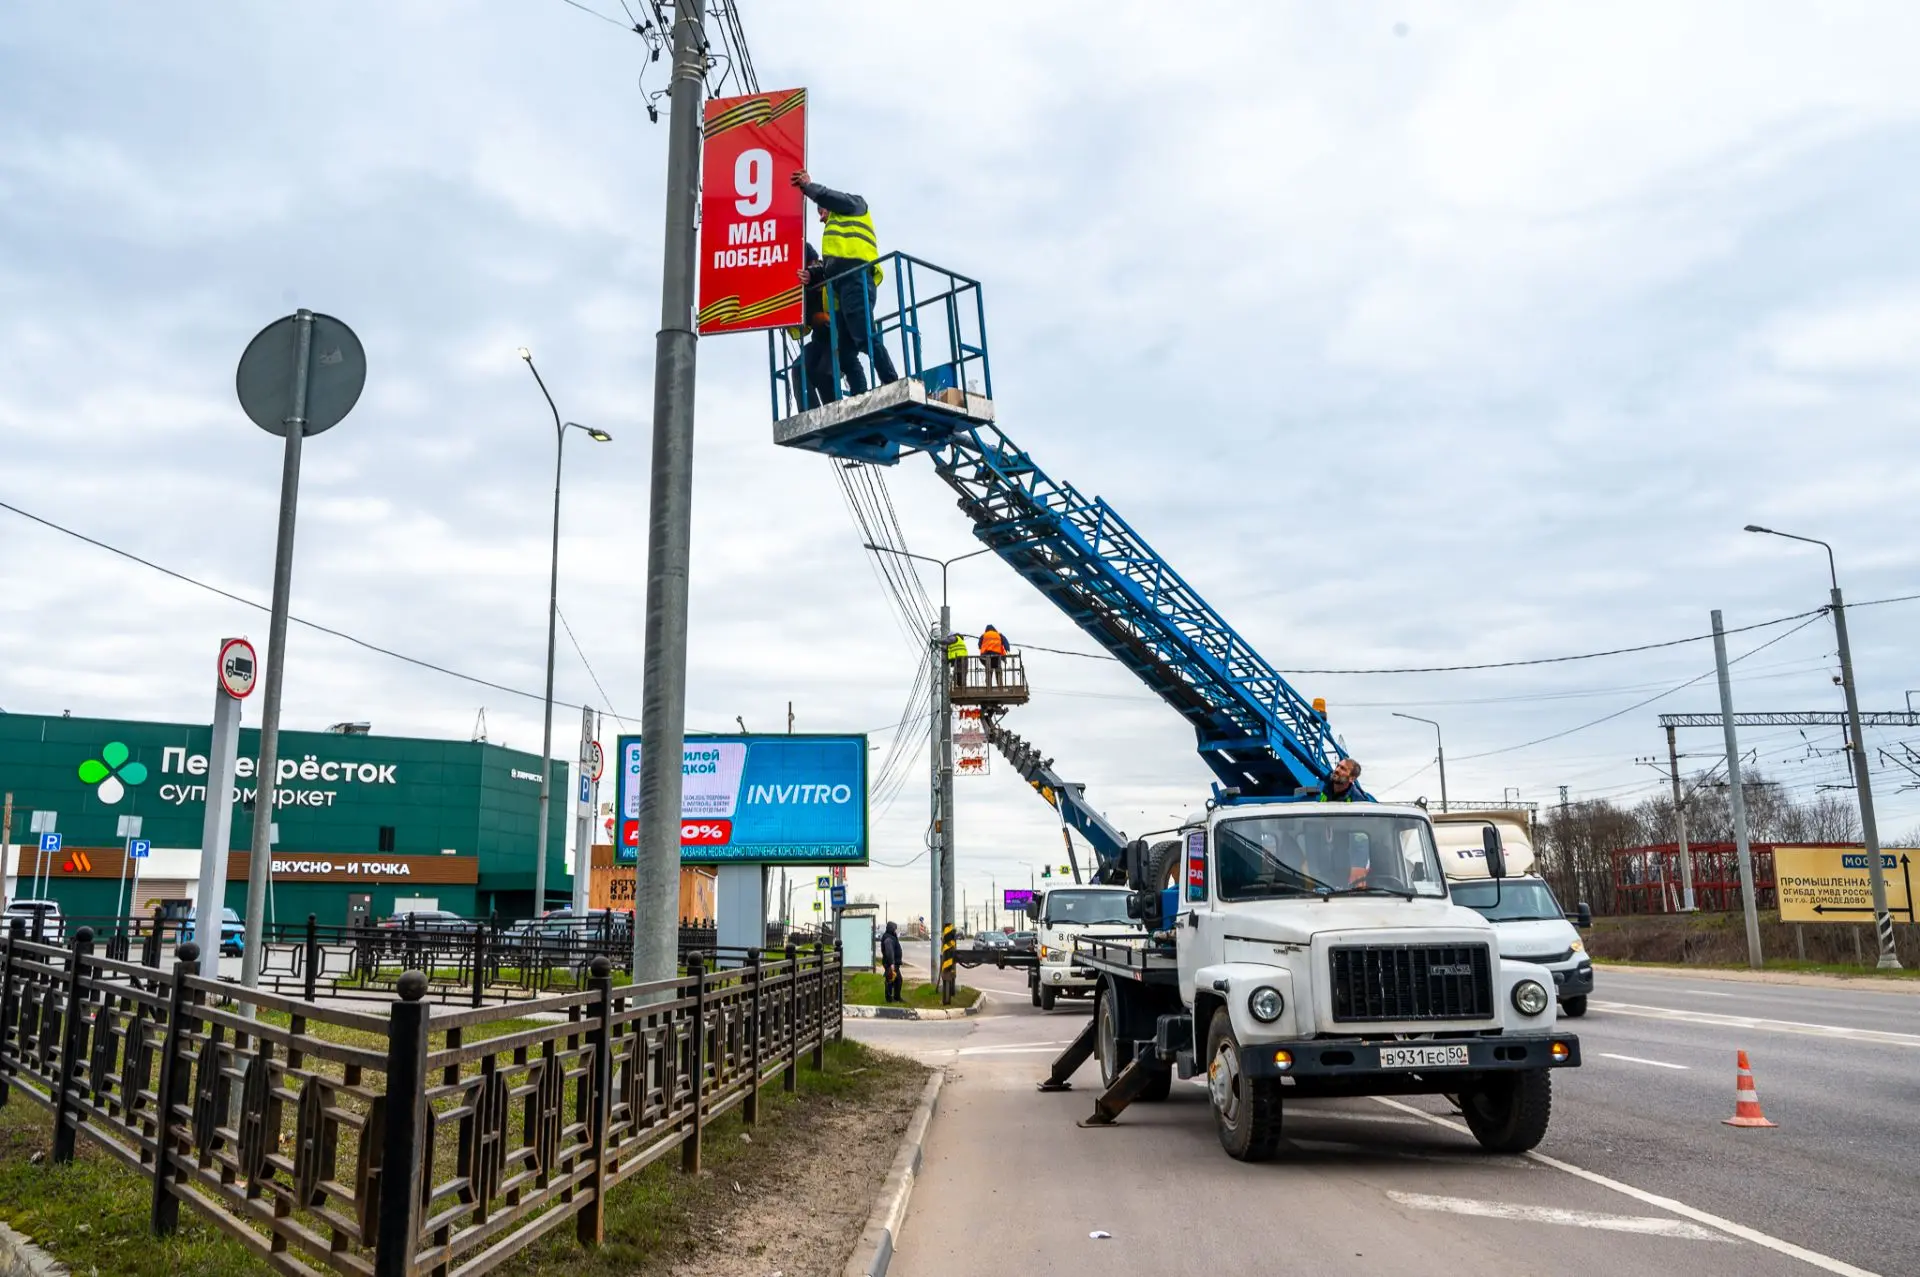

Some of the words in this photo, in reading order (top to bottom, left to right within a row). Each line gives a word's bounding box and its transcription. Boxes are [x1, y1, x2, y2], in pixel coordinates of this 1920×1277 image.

[735, 148, 773, 217] 9
[728, 219, 777, 246] МАЯ
[714, 243, 789, 269] ПОБЕДА!
[683, 749, 720, 761] илей
[161, 747, 397, 785] Пеерёсток
[682, 762, 717, 775] дкой
[746, 784, 852, 804] INVITRO
[681, 825, 723, 839] 0%
[271, 860, 332, 873] ВКУСНО
[347, 862, 359, 874] И
[362, 863, 411, 875] ТОЧКА
[1844, 857, 1895, 867] МОСВА
[610, 879, 637, 887] ОСТО
[610, 886, 637, 894] КРУ
[1818, 888, 1841, 897] УМВД
[1809, 896, 1867, 905] ДОМОДЕДОВО
